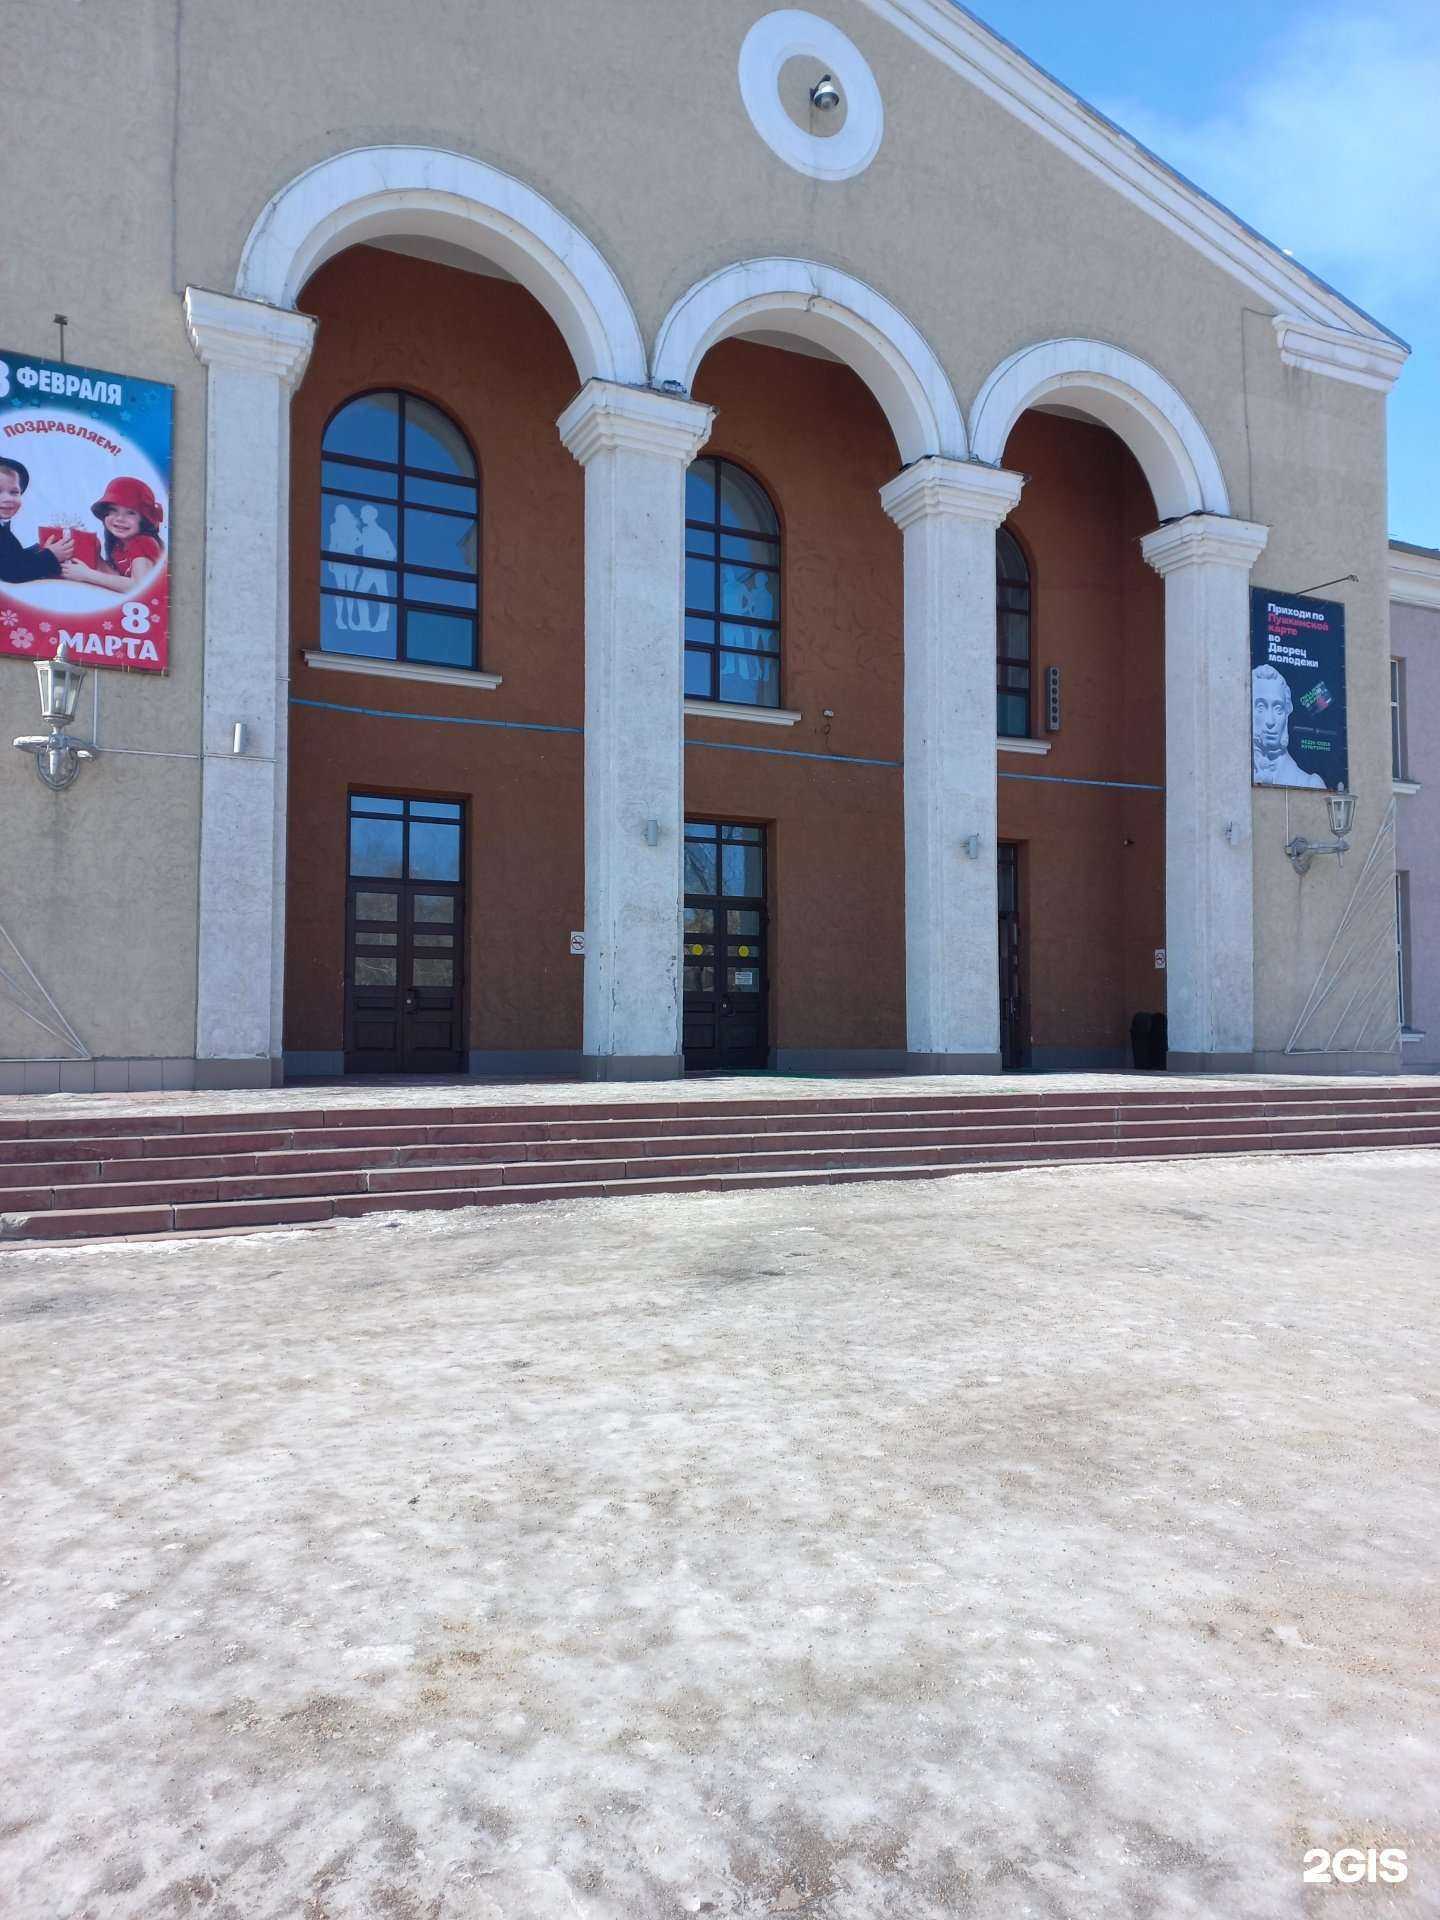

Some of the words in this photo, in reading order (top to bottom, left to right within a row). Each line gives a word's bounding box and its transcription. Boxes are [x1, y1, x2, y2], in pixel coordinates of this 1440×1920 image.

[16, 366, 122, 406] ФЕВРАЛЯ
[3, 420, 122, 456] ПОЗДРАВЛЯЕМ!
[121, 601, 151, 634] 8
[1268, 603, 1311, 619] Приходи
[1312, 612, 1325, 621] по
[58, 629, 159, 661] МАРТА
[1268, 634, 1281, 642] во
[1268, 642, 1307, 658] Дворец
[1268, 654, 1319, 668] молодежи
